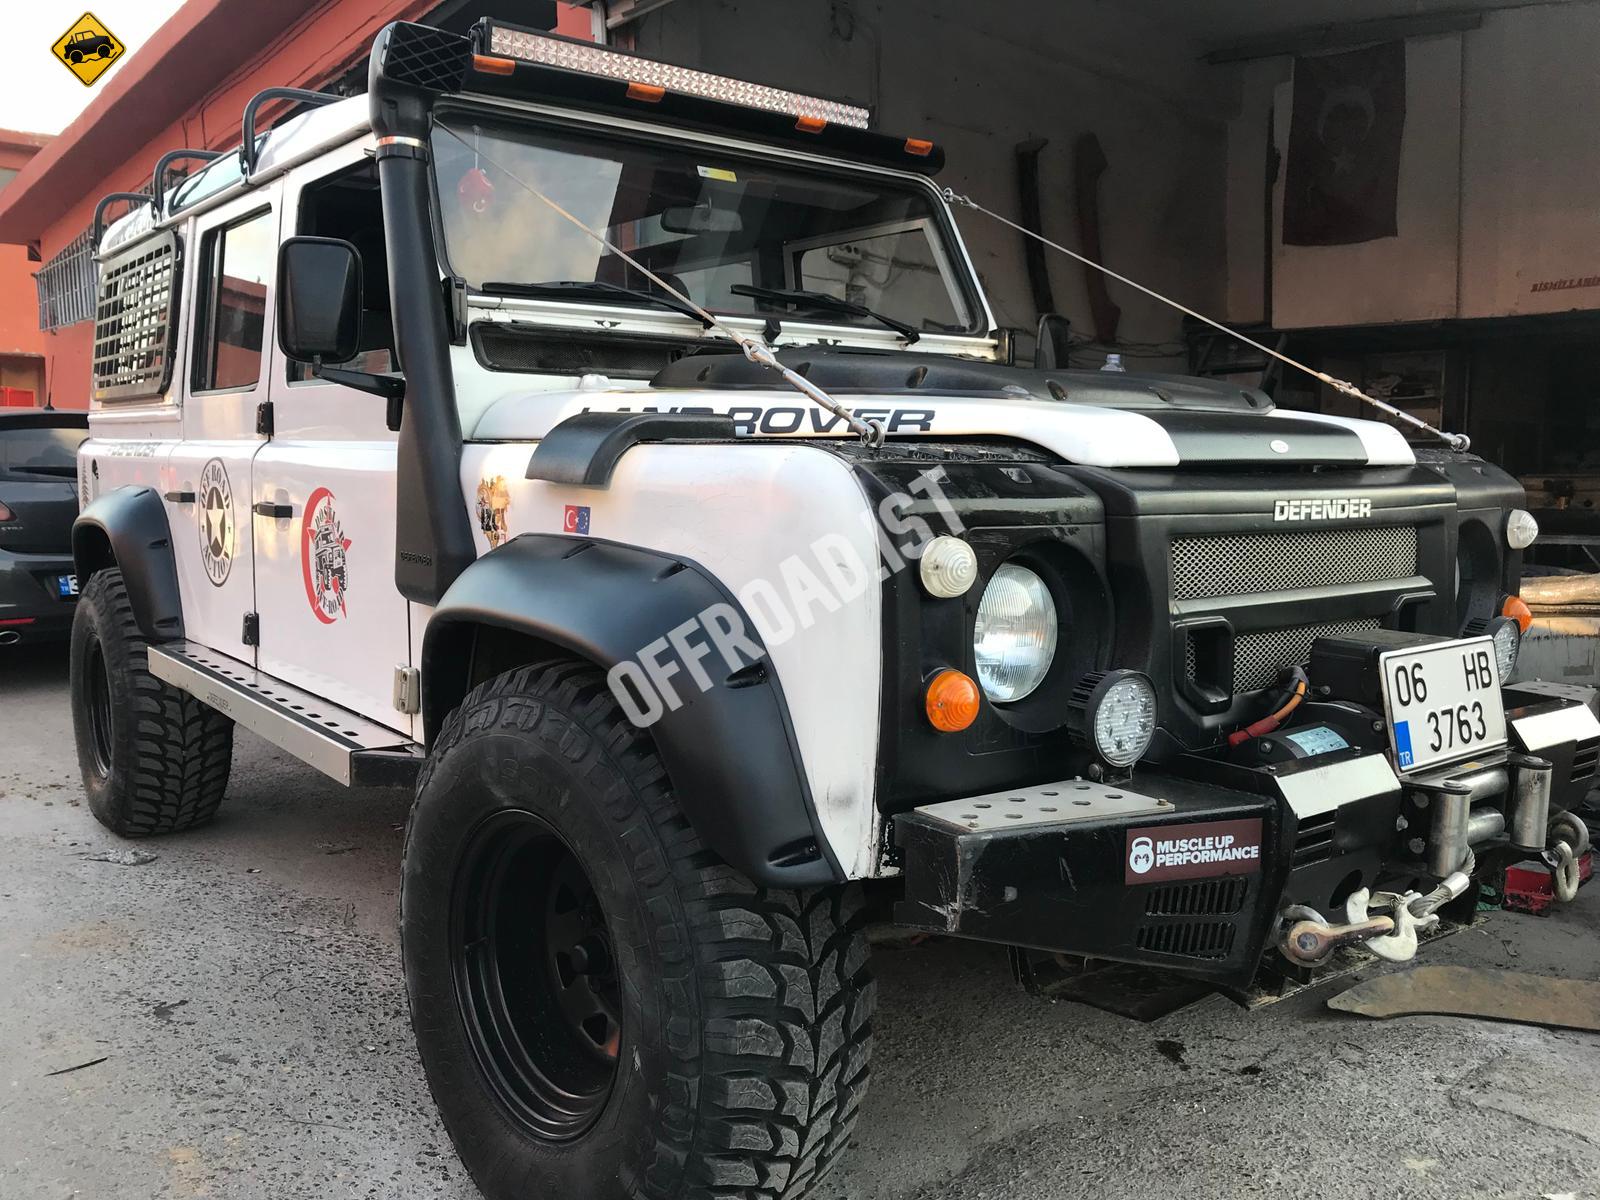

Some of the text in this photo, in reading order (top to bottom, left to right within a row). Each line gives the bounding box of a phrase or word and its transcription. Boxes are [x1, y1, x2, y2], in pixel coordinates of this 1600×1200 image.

[728, 407, 935, 433] ROVER
[1274, 498, 1371, 521] DEFENDER
[1395, 651, 1493, 706] 06 HB
[1400, 701, 1487, 766] TR 3763
[1156, 835, 1235, 854] MUSCLE UP
[1156, 846, 1259, 867] PERFORMANCE
